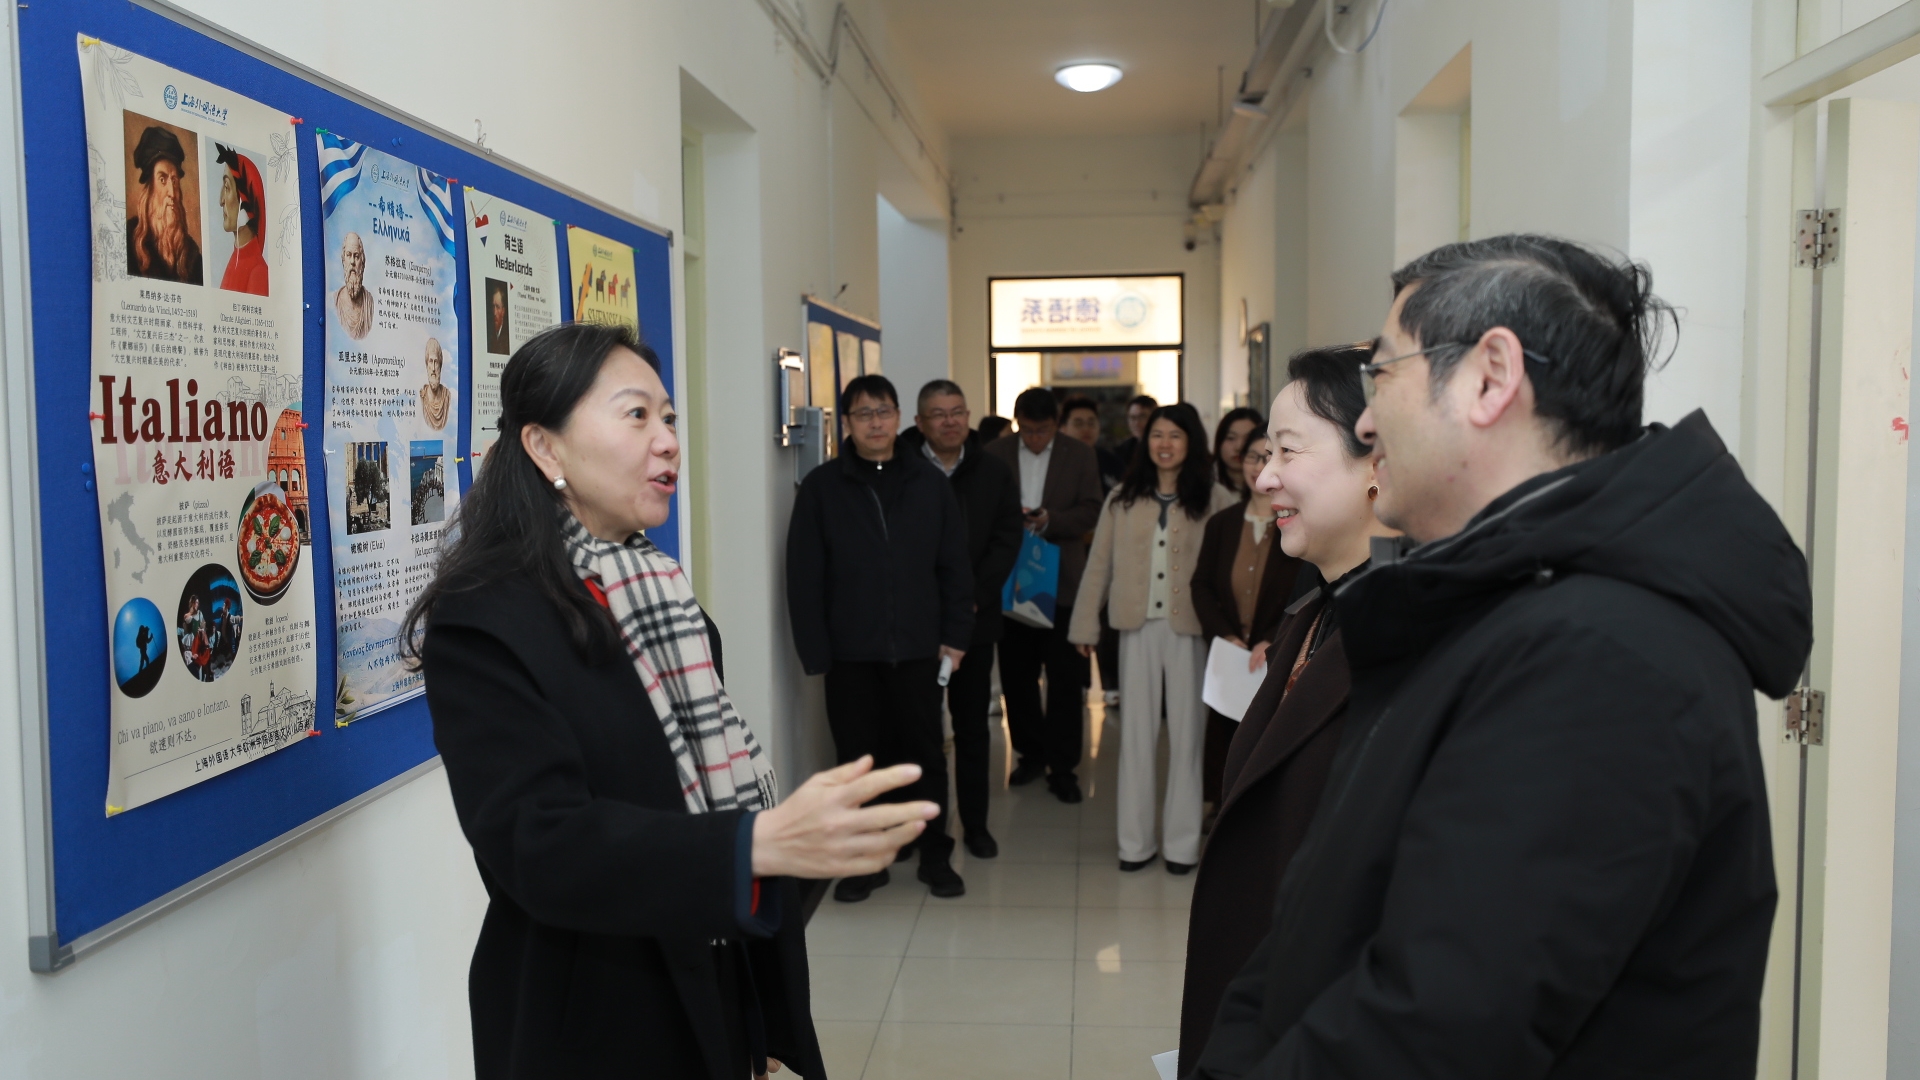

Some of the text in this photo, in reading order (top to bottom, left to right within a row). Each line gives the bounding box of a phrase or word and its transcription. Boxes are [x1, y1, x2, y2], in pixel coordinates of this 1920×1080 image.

[373, 217, 410, 243] Ελληνικά
[504, 233, 524, 255] 荷兰语
[385, 255, 407, 270] 苏格拉底
[495, 254, 533, 277] Nederlands
[148, 304, 154, 314] da
[338, 351, 369, 365] 亚里士多德
[99, 375, 268, 444] Italiano
[152, 448, 236, 485] 意大利语
[117, 699, 231, 745] Chi va piano, va sano e lontano.
[149, 728, 197, 755] 欲速则不达。
